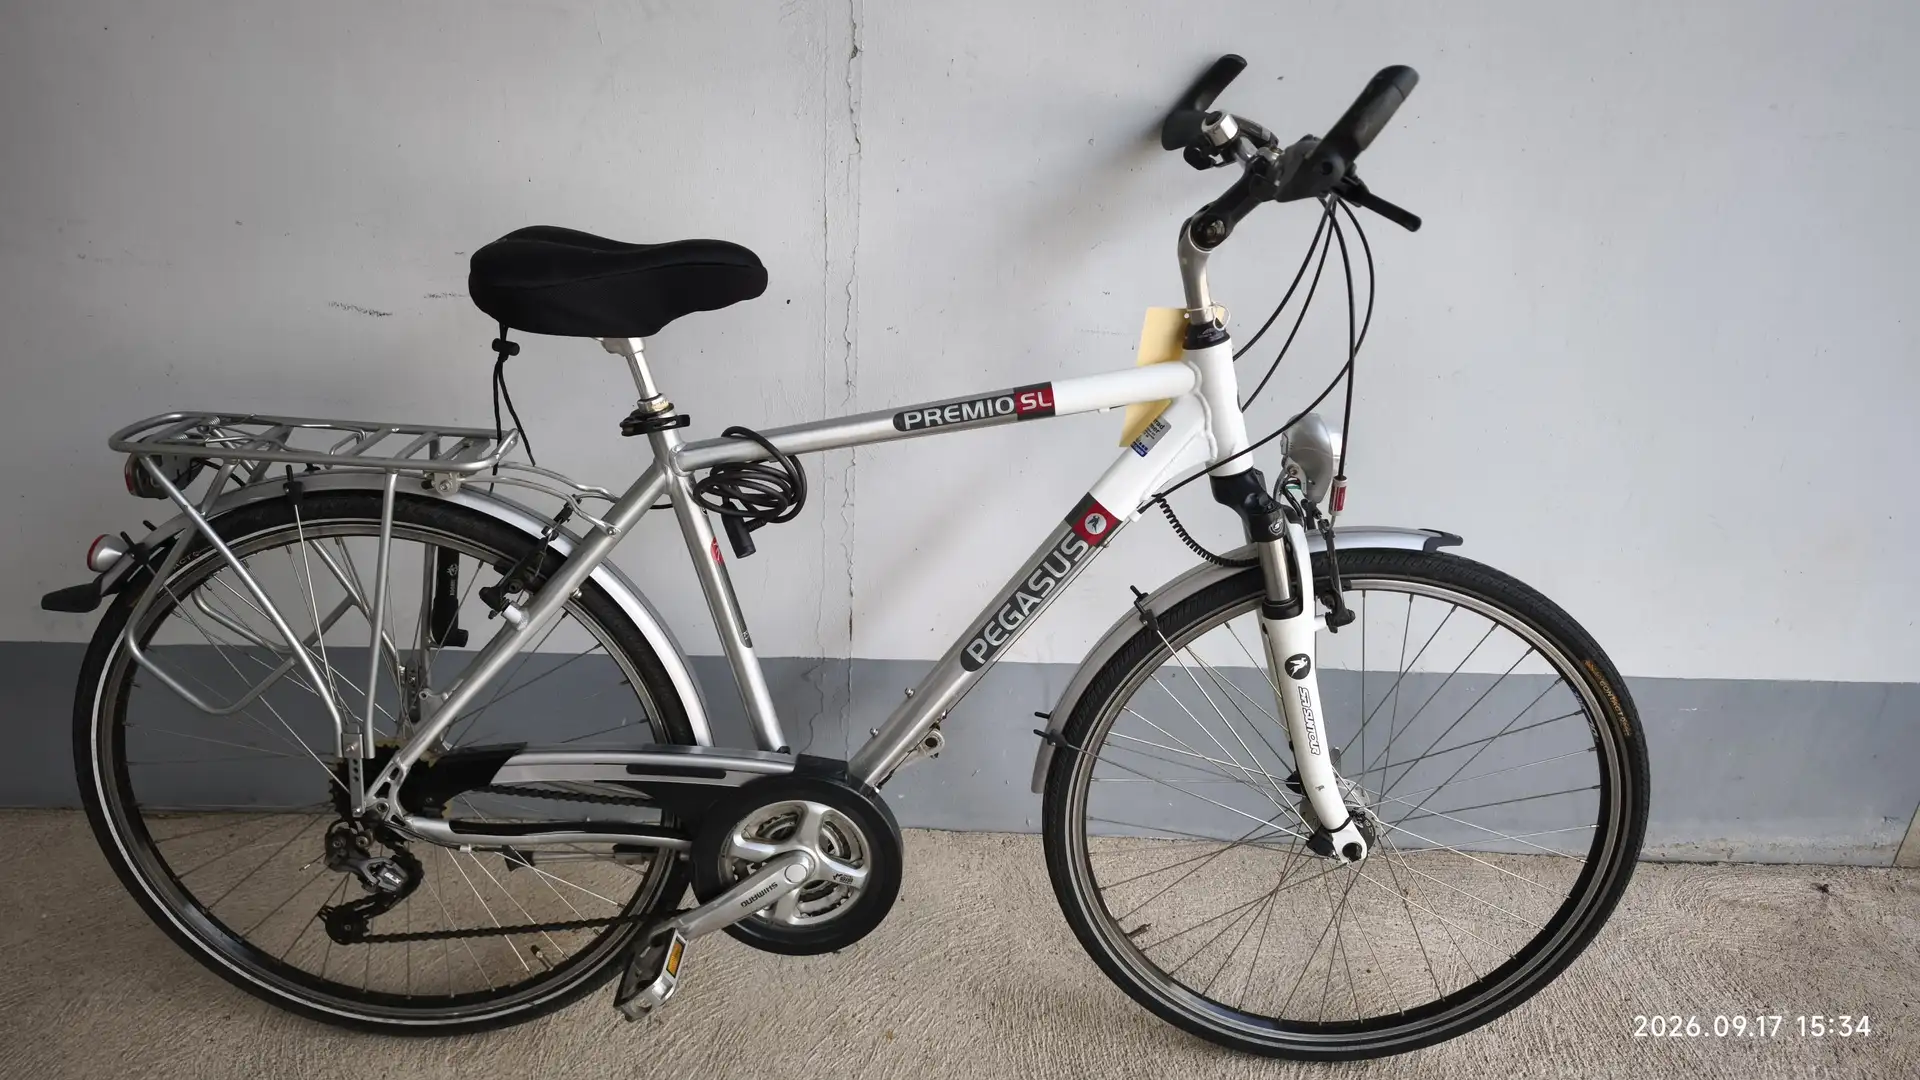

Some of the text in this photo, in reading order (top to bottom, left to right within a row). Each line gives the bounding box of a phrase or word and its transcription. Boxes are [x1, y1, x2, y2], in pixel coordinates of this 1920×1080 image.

[903, 391, 1052, 430] PREMIO SL
[966, 532, 1089, 665] PEGASUS
[1302, 707, 1321, 755] SUNTOUR
[740, 882, 778, 907] SHIMANO
